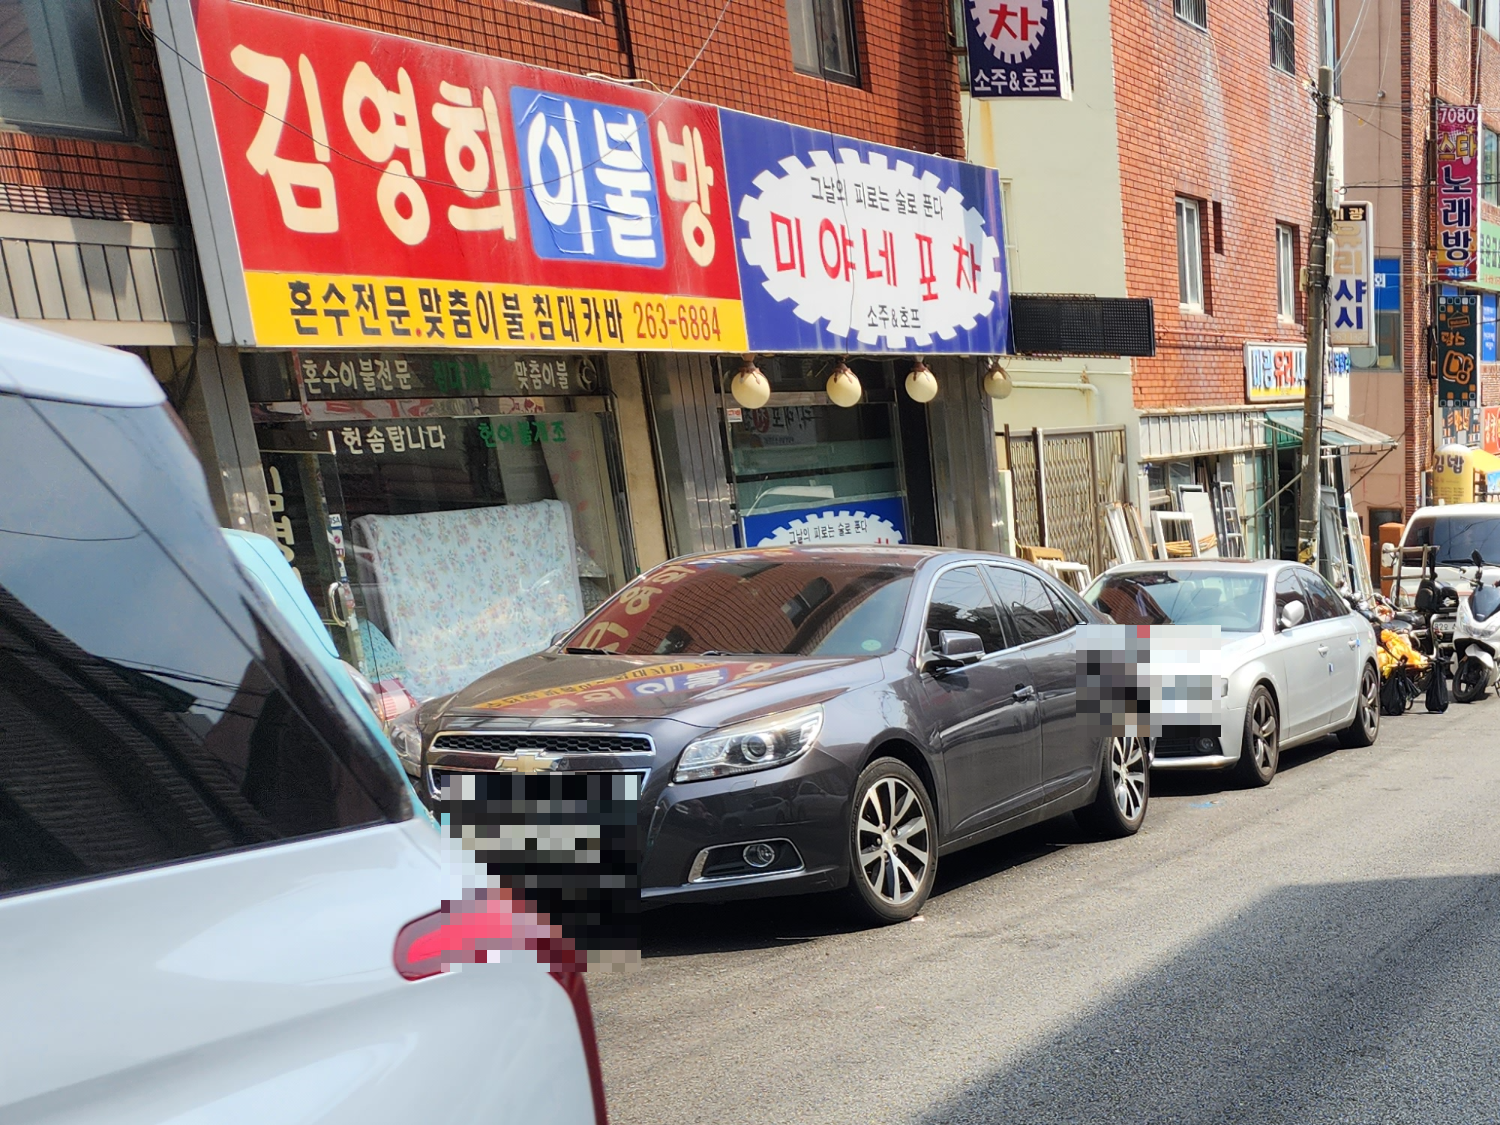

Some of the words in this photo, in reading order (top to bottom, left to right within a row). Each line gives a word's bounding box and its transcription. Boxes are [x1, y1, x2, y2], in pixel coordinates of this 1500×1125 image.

[989, 7, 1039, 41] 차
[973, 68, 1056, 93] 소주&호프
[1440, 108, 1476, 125] 7080
[230, 44, 516, 246] 김영희
[526, 101, 717, 268] 이불방
[1439, 133, 1477, 160] 스타
[811, 176, 848, 206] 그날의
[854, 181, 890, 213] 피로는
[895, 189, 918, 215] 술로
[923, 192, 944, 220] 푼다
[1441, 166, 1472, 261] 노래방
[770, 211, 897, 288] 미야네
[633, 301, 721, 342] 263-6884
[868, 306, 921, 329] 소주&호프
[302, 359, 412, 394] 혼수이불전문
[514, 360, 569, 392] 맞춤이불
